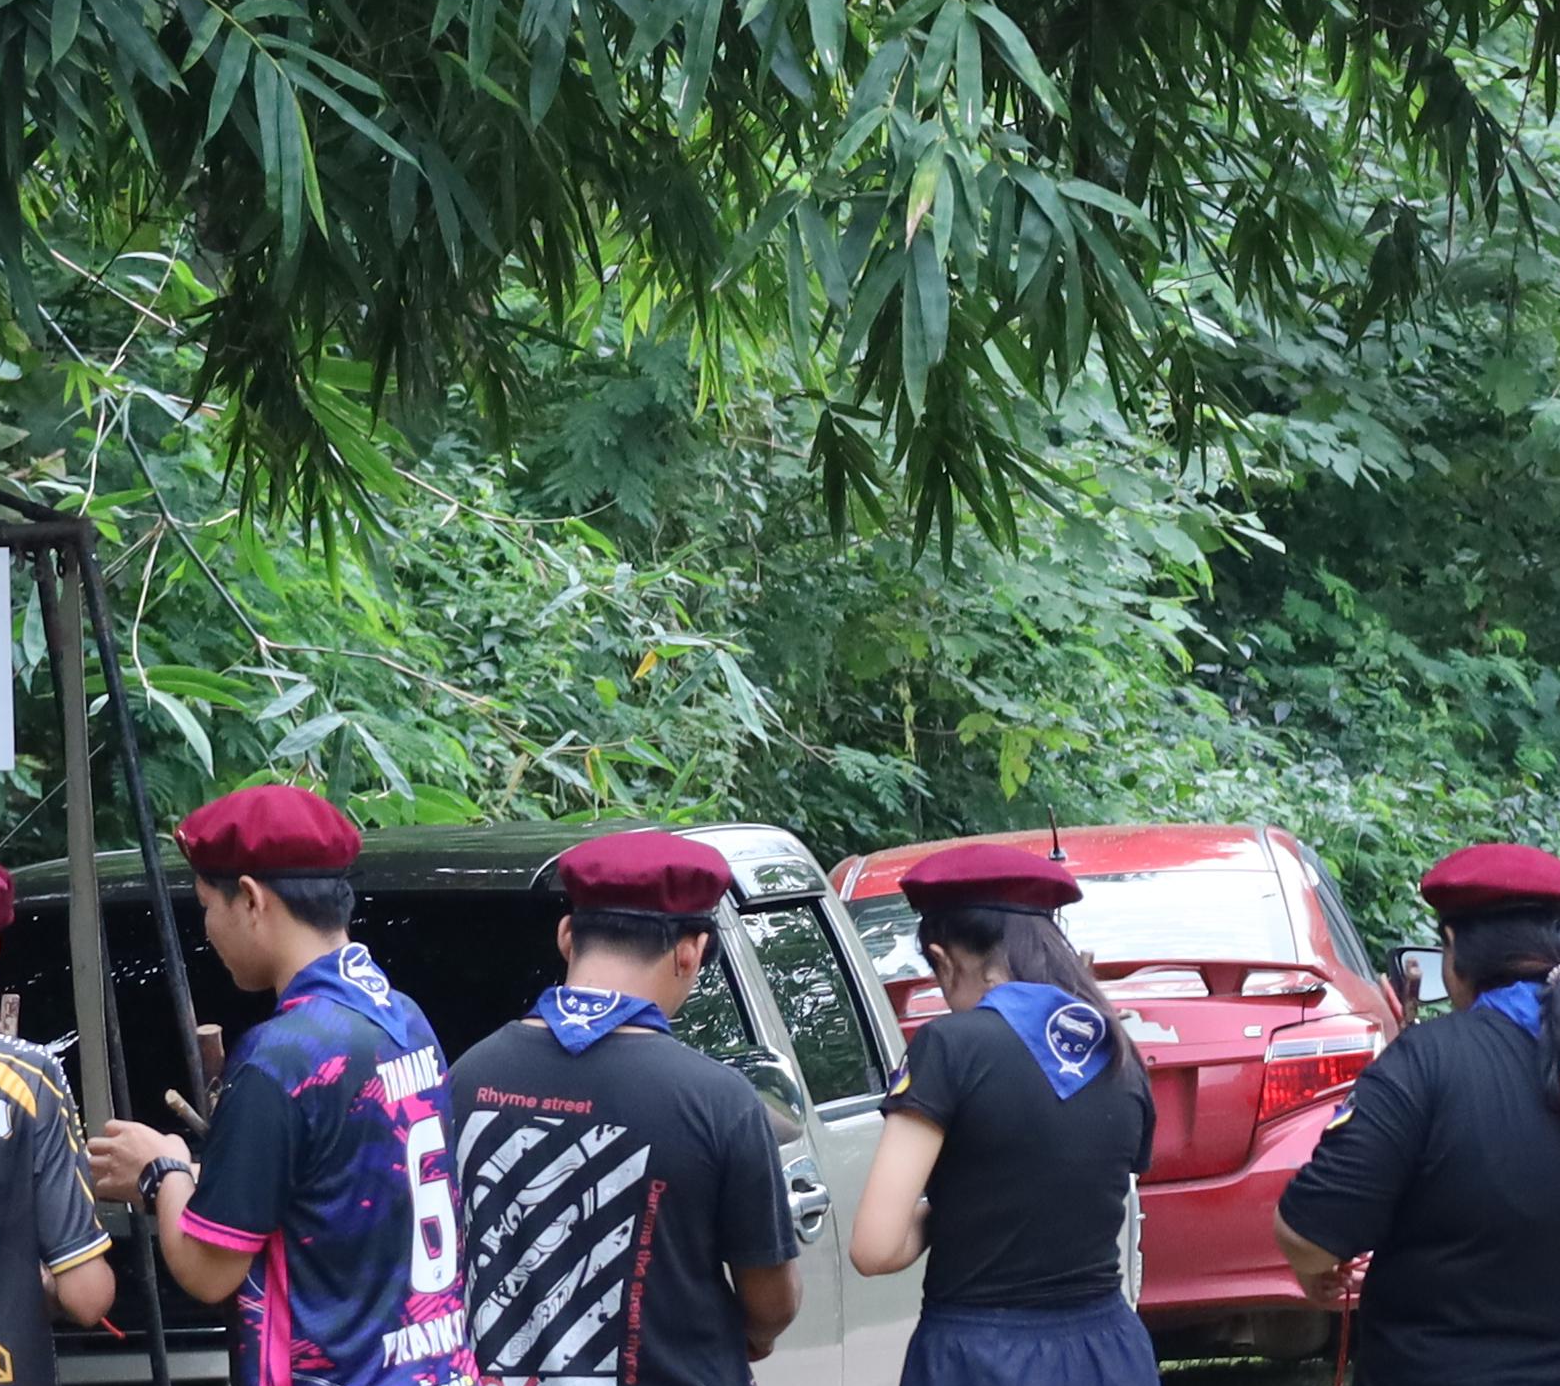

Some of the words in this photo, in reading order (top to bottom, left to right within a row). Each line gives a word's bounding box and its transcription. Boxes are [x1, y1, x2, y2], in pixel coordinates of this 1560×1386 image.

[477, 1087, 538, 1109] Rhyme
[541, 1097, 594, 1113] street
[407, 1116, 457, 1293] 6
[634, 1249, 651, 1278] the
[629, 1281, 644, 1330] street
